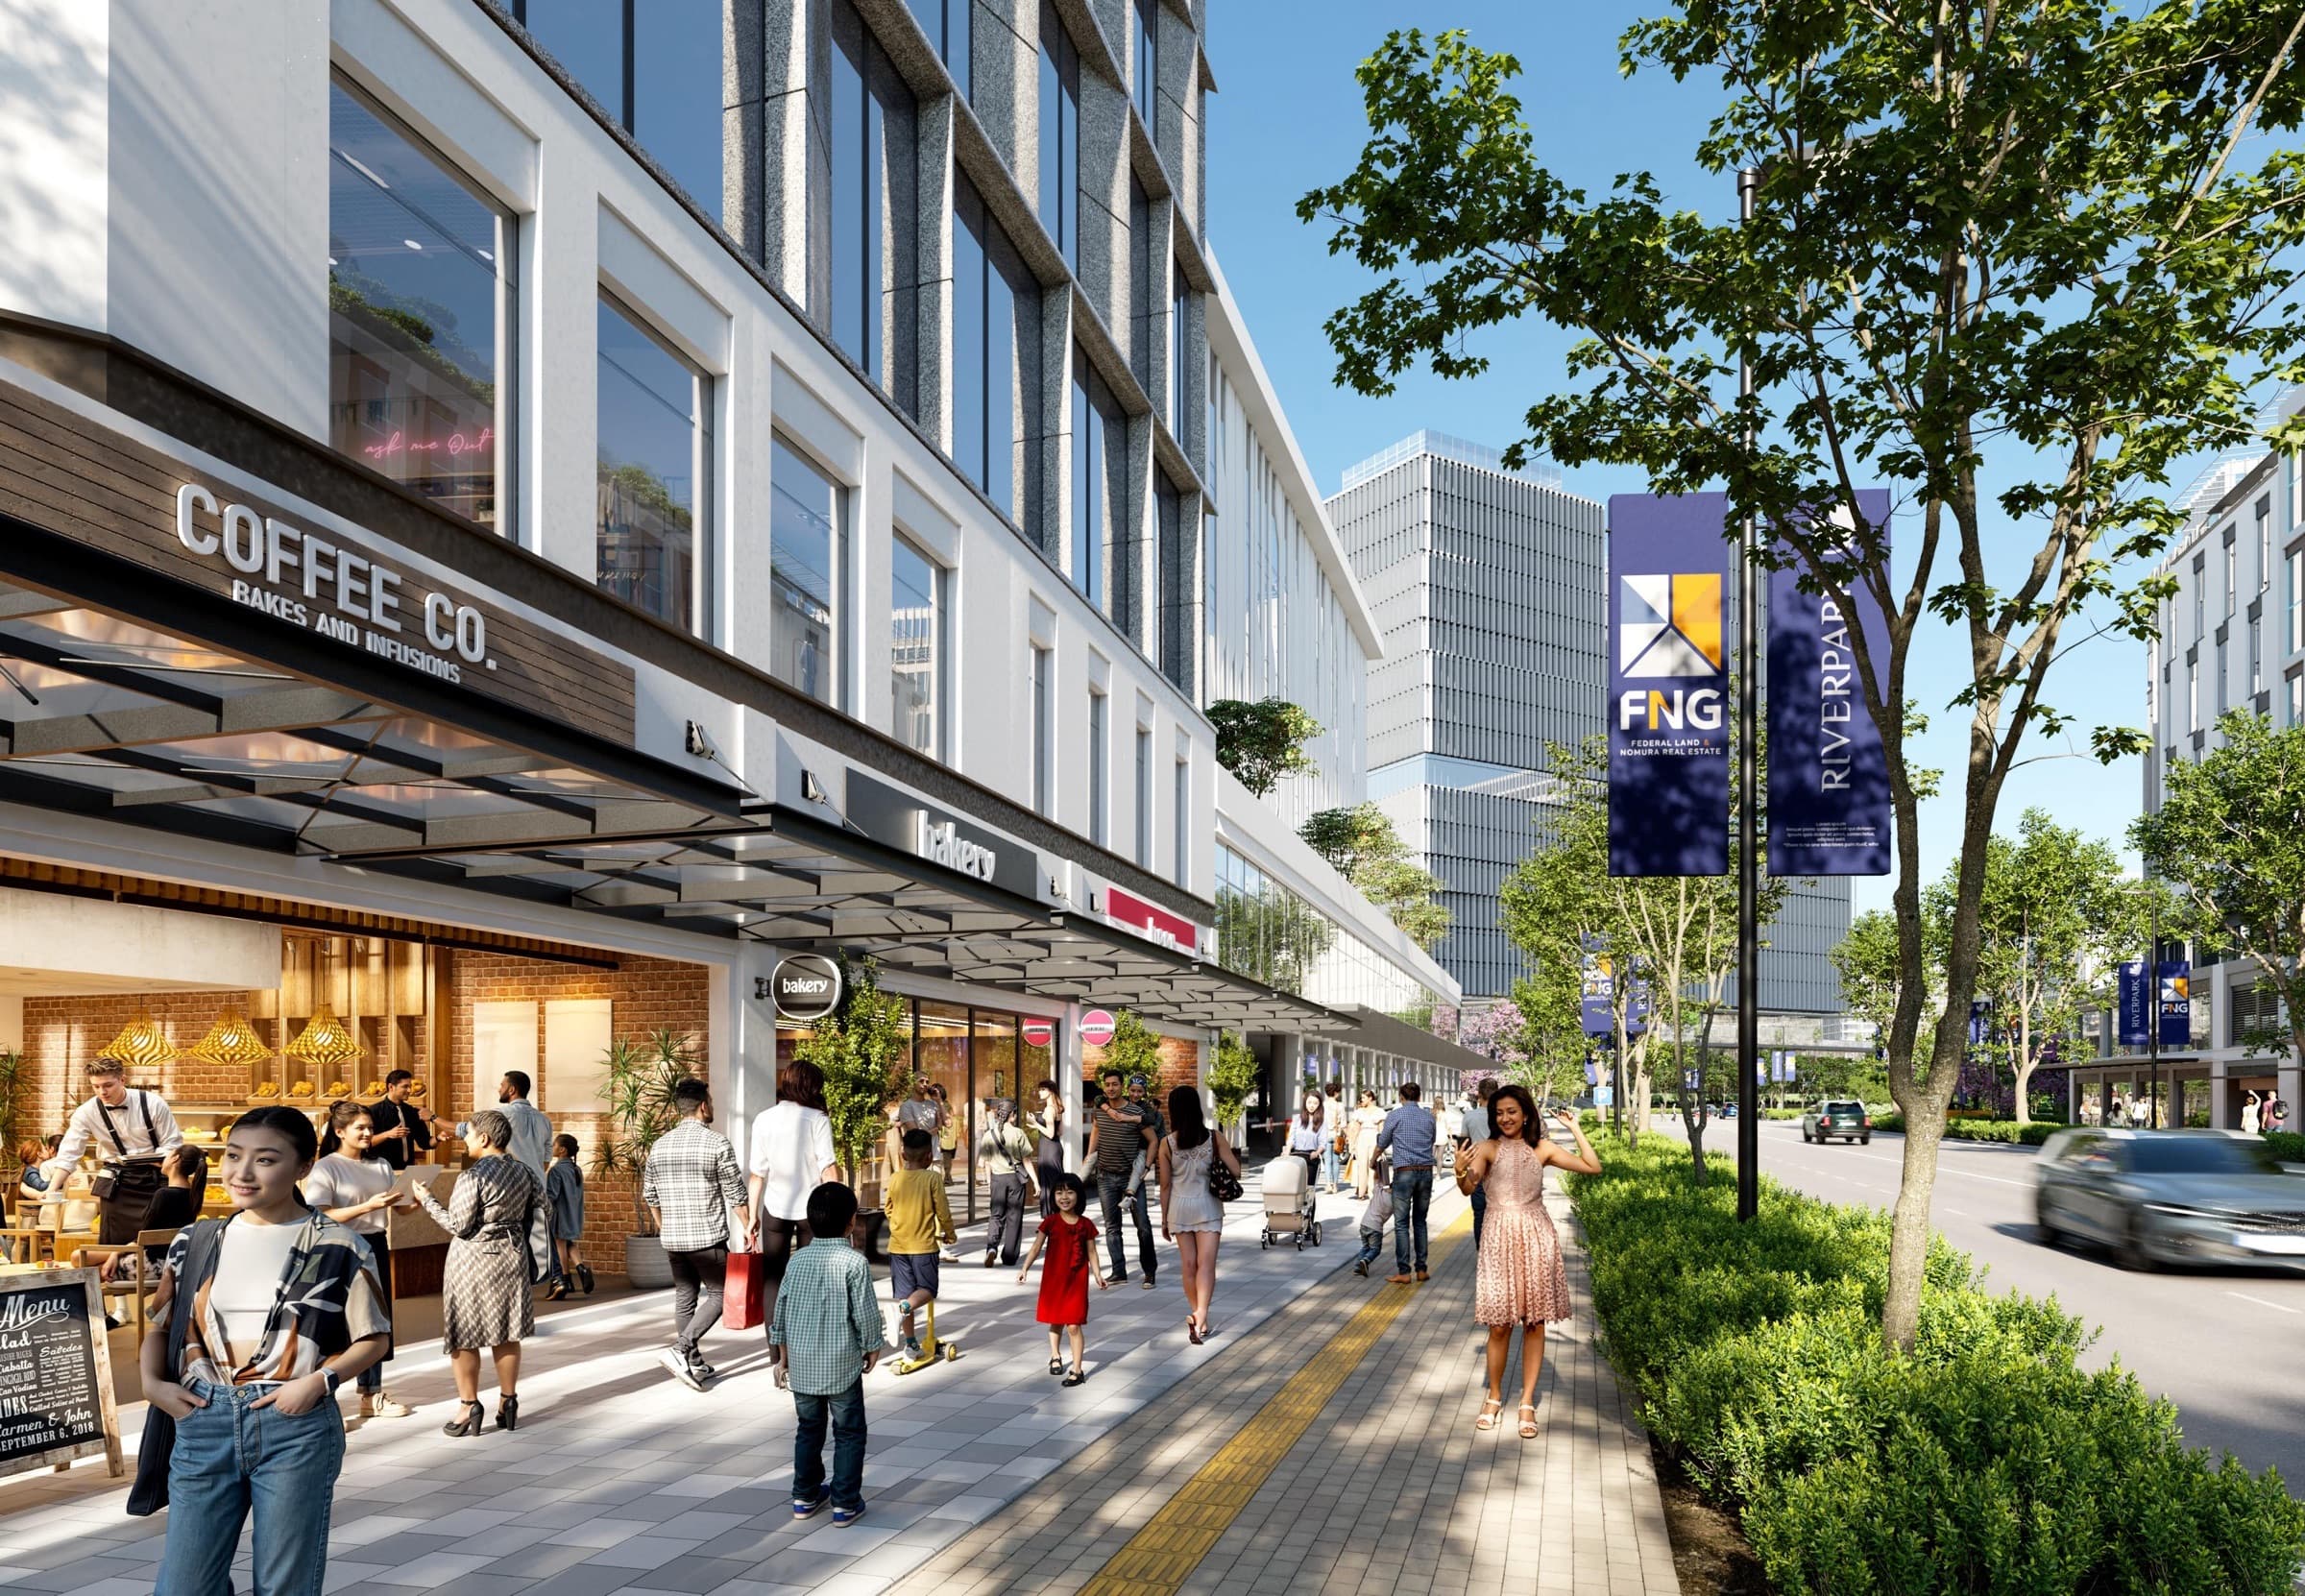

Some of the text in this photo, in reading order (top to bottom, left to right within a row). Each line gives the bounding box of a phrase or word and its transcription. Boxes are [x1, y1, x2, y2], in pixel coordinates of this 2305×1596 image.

[364, 431, 402, 459] ask
[409, 441, 439, 451] me
[176, 483, 497, 671] COFFEE CO.
[232, 579, 461, 685] BAKES AND INFUSIONS
[1821, 578, 1852, 794] RIVERPAR
[1619, 688, 1722, 731] FNG
[1619, 748, 1661, 757] NOMURA
[1687, 747, 1722, 756] ESTATE
[1631, 738, 1672, 748] FEDERAL
[1674, 738, 1700, 747] LAND
[917, 809, 996, 883] bakery
[783, 978, 828, 994] bakery
[2131, 979, 2141, 1028] RIVERPARK
[2161, 1003, 2189, 1014] FNG
[1598, 1090, 1608, 1102] P
[0, 1294, 71, 1330] Menu
[0, 1330, 32, 1350] lad
[0, 1407, 92, 1438] armen & John
[0, 1421, 94, 1453] EPTEMBER 6. 2018
